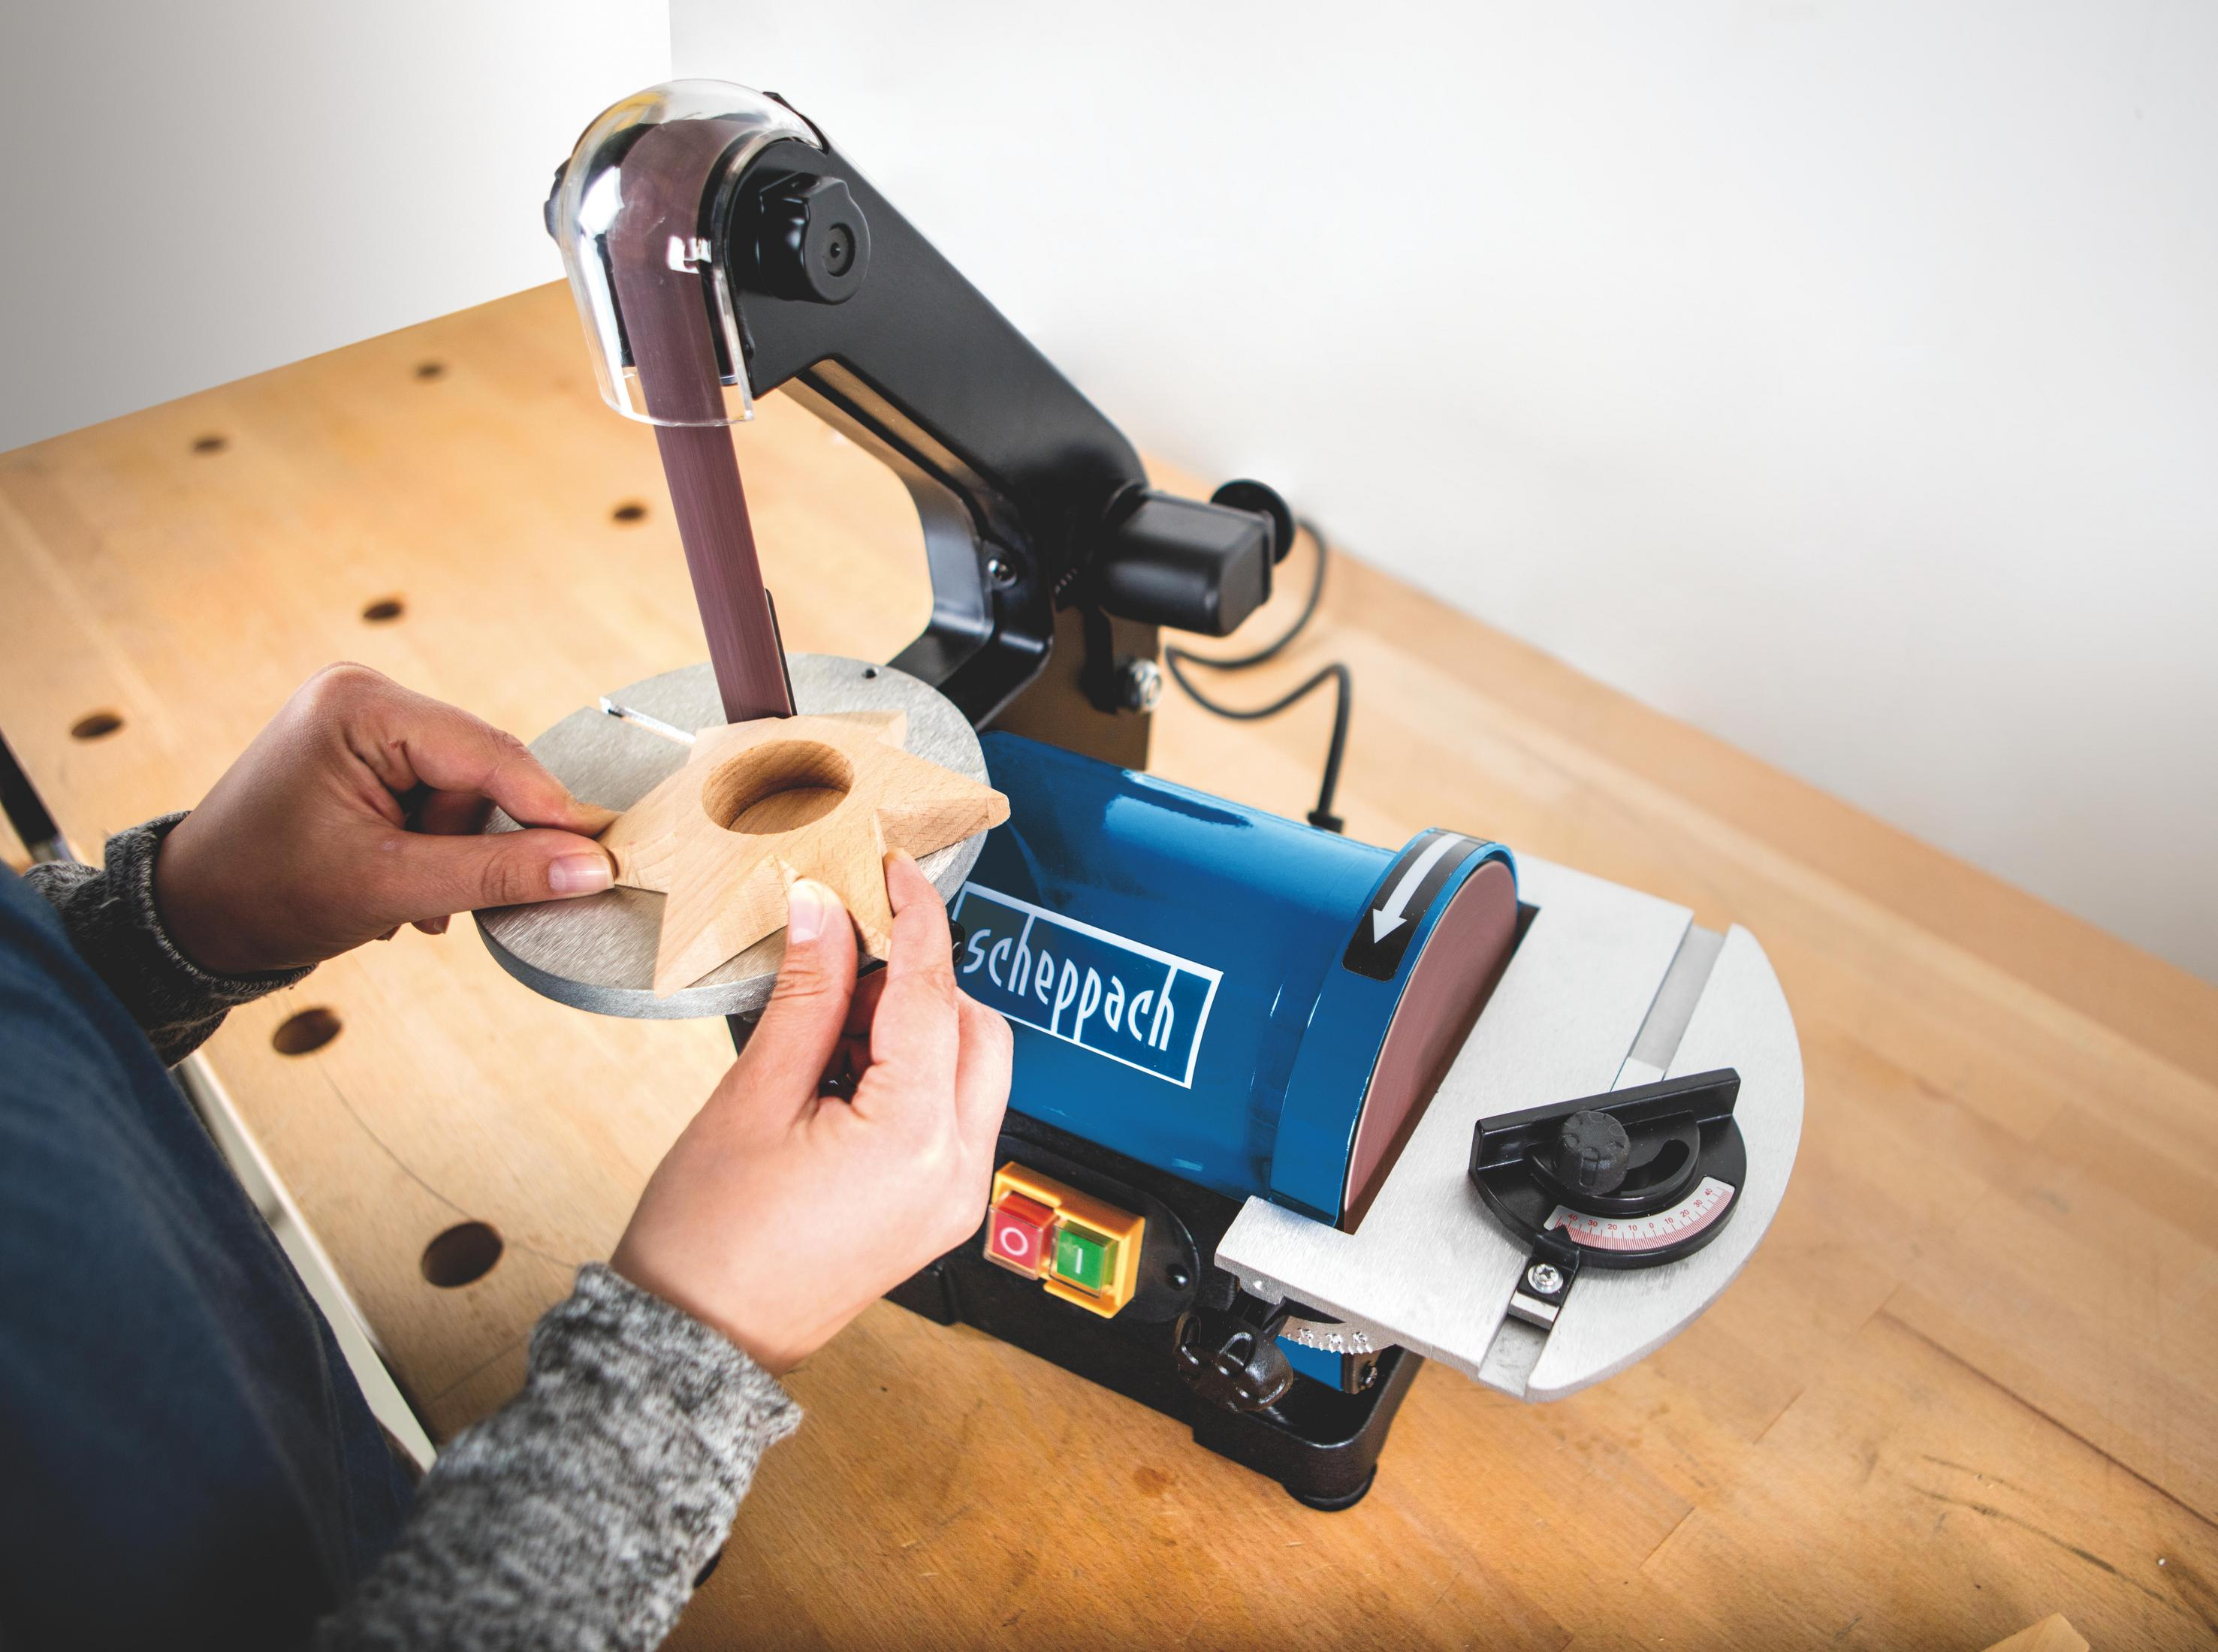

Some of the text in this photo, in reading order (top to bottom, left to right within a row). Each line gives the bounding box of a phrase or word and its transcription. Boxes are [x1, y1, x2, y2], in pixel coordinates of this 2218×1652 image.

[962, 914, 1178, 1052] scheppach
[1568, 1213, 1578, 1221] 40
[1664, 1216, 1674, 1225] 10
[1679, 1209, 1690, 1218] 20
[1693, 1199, 1703, 1207] 30
[1704, 1188, 1713, 1196] 40
